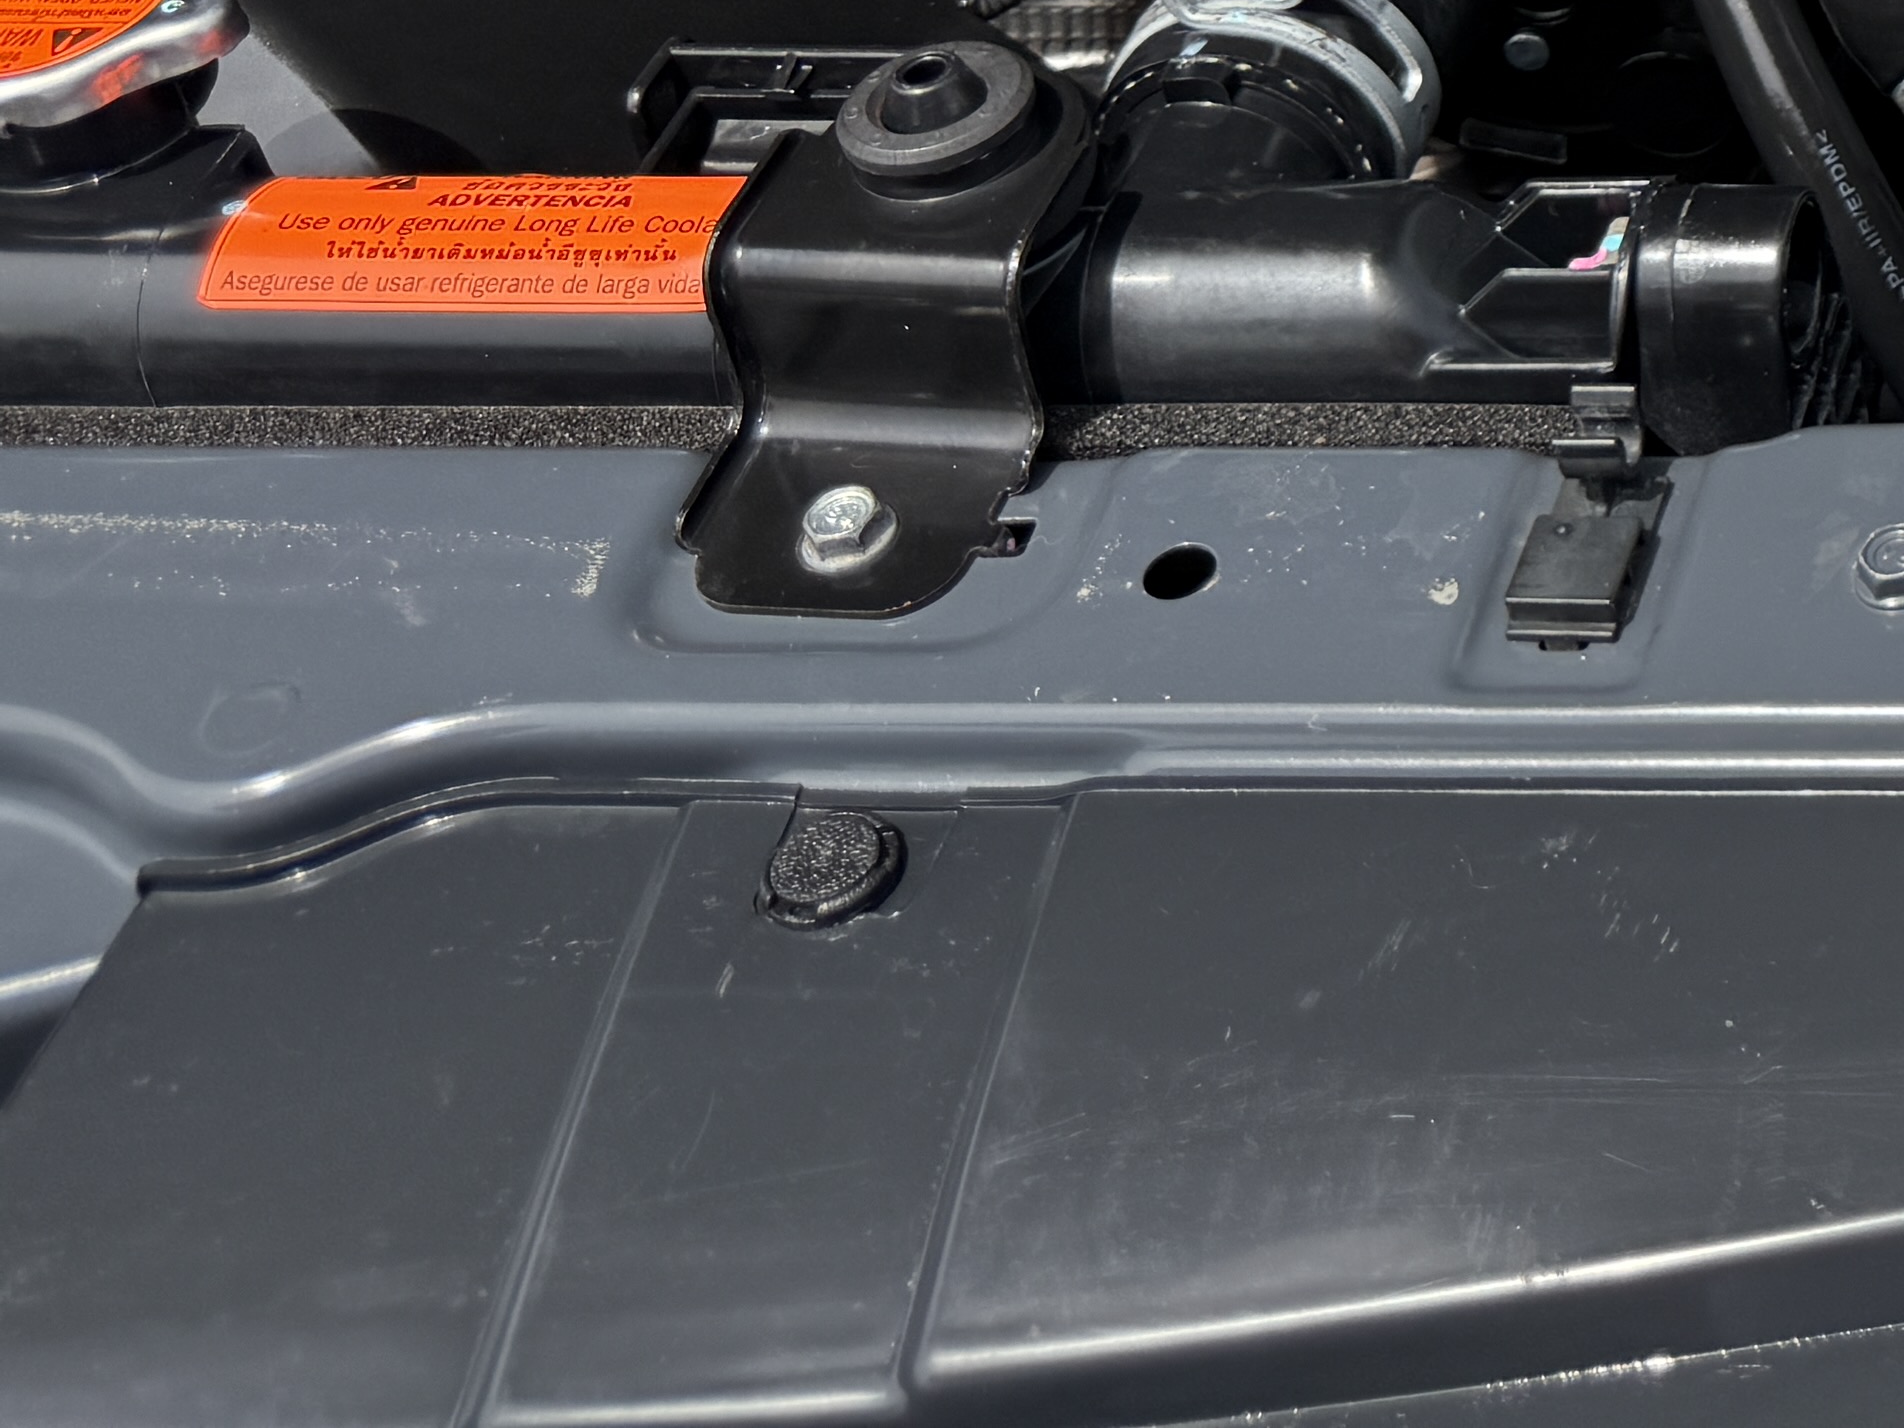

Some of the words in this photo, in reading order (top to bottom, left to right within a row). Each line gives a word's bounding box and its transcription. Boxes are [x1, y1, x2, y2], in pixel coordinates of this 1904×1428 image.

[427, 193, 633, 209] ADVERTENCIA
[278, 213, 330, 232] Use
[338, 213, 394, 236] only
[402, 214, 501, 237] genuine
[515, 214, 579, 237] Long
[587, 214, 636, 235] Life
[644, 215, 718, 234] Coola
[221, 270, 334, 295] Asegurese
[341, 271, 371, 294] de
[375, 275, 424, 294] usar
[430, 272, 556, 298] refrigerante
[561, 272, 590, 294] de
[597, 273, 651, 298] larga
